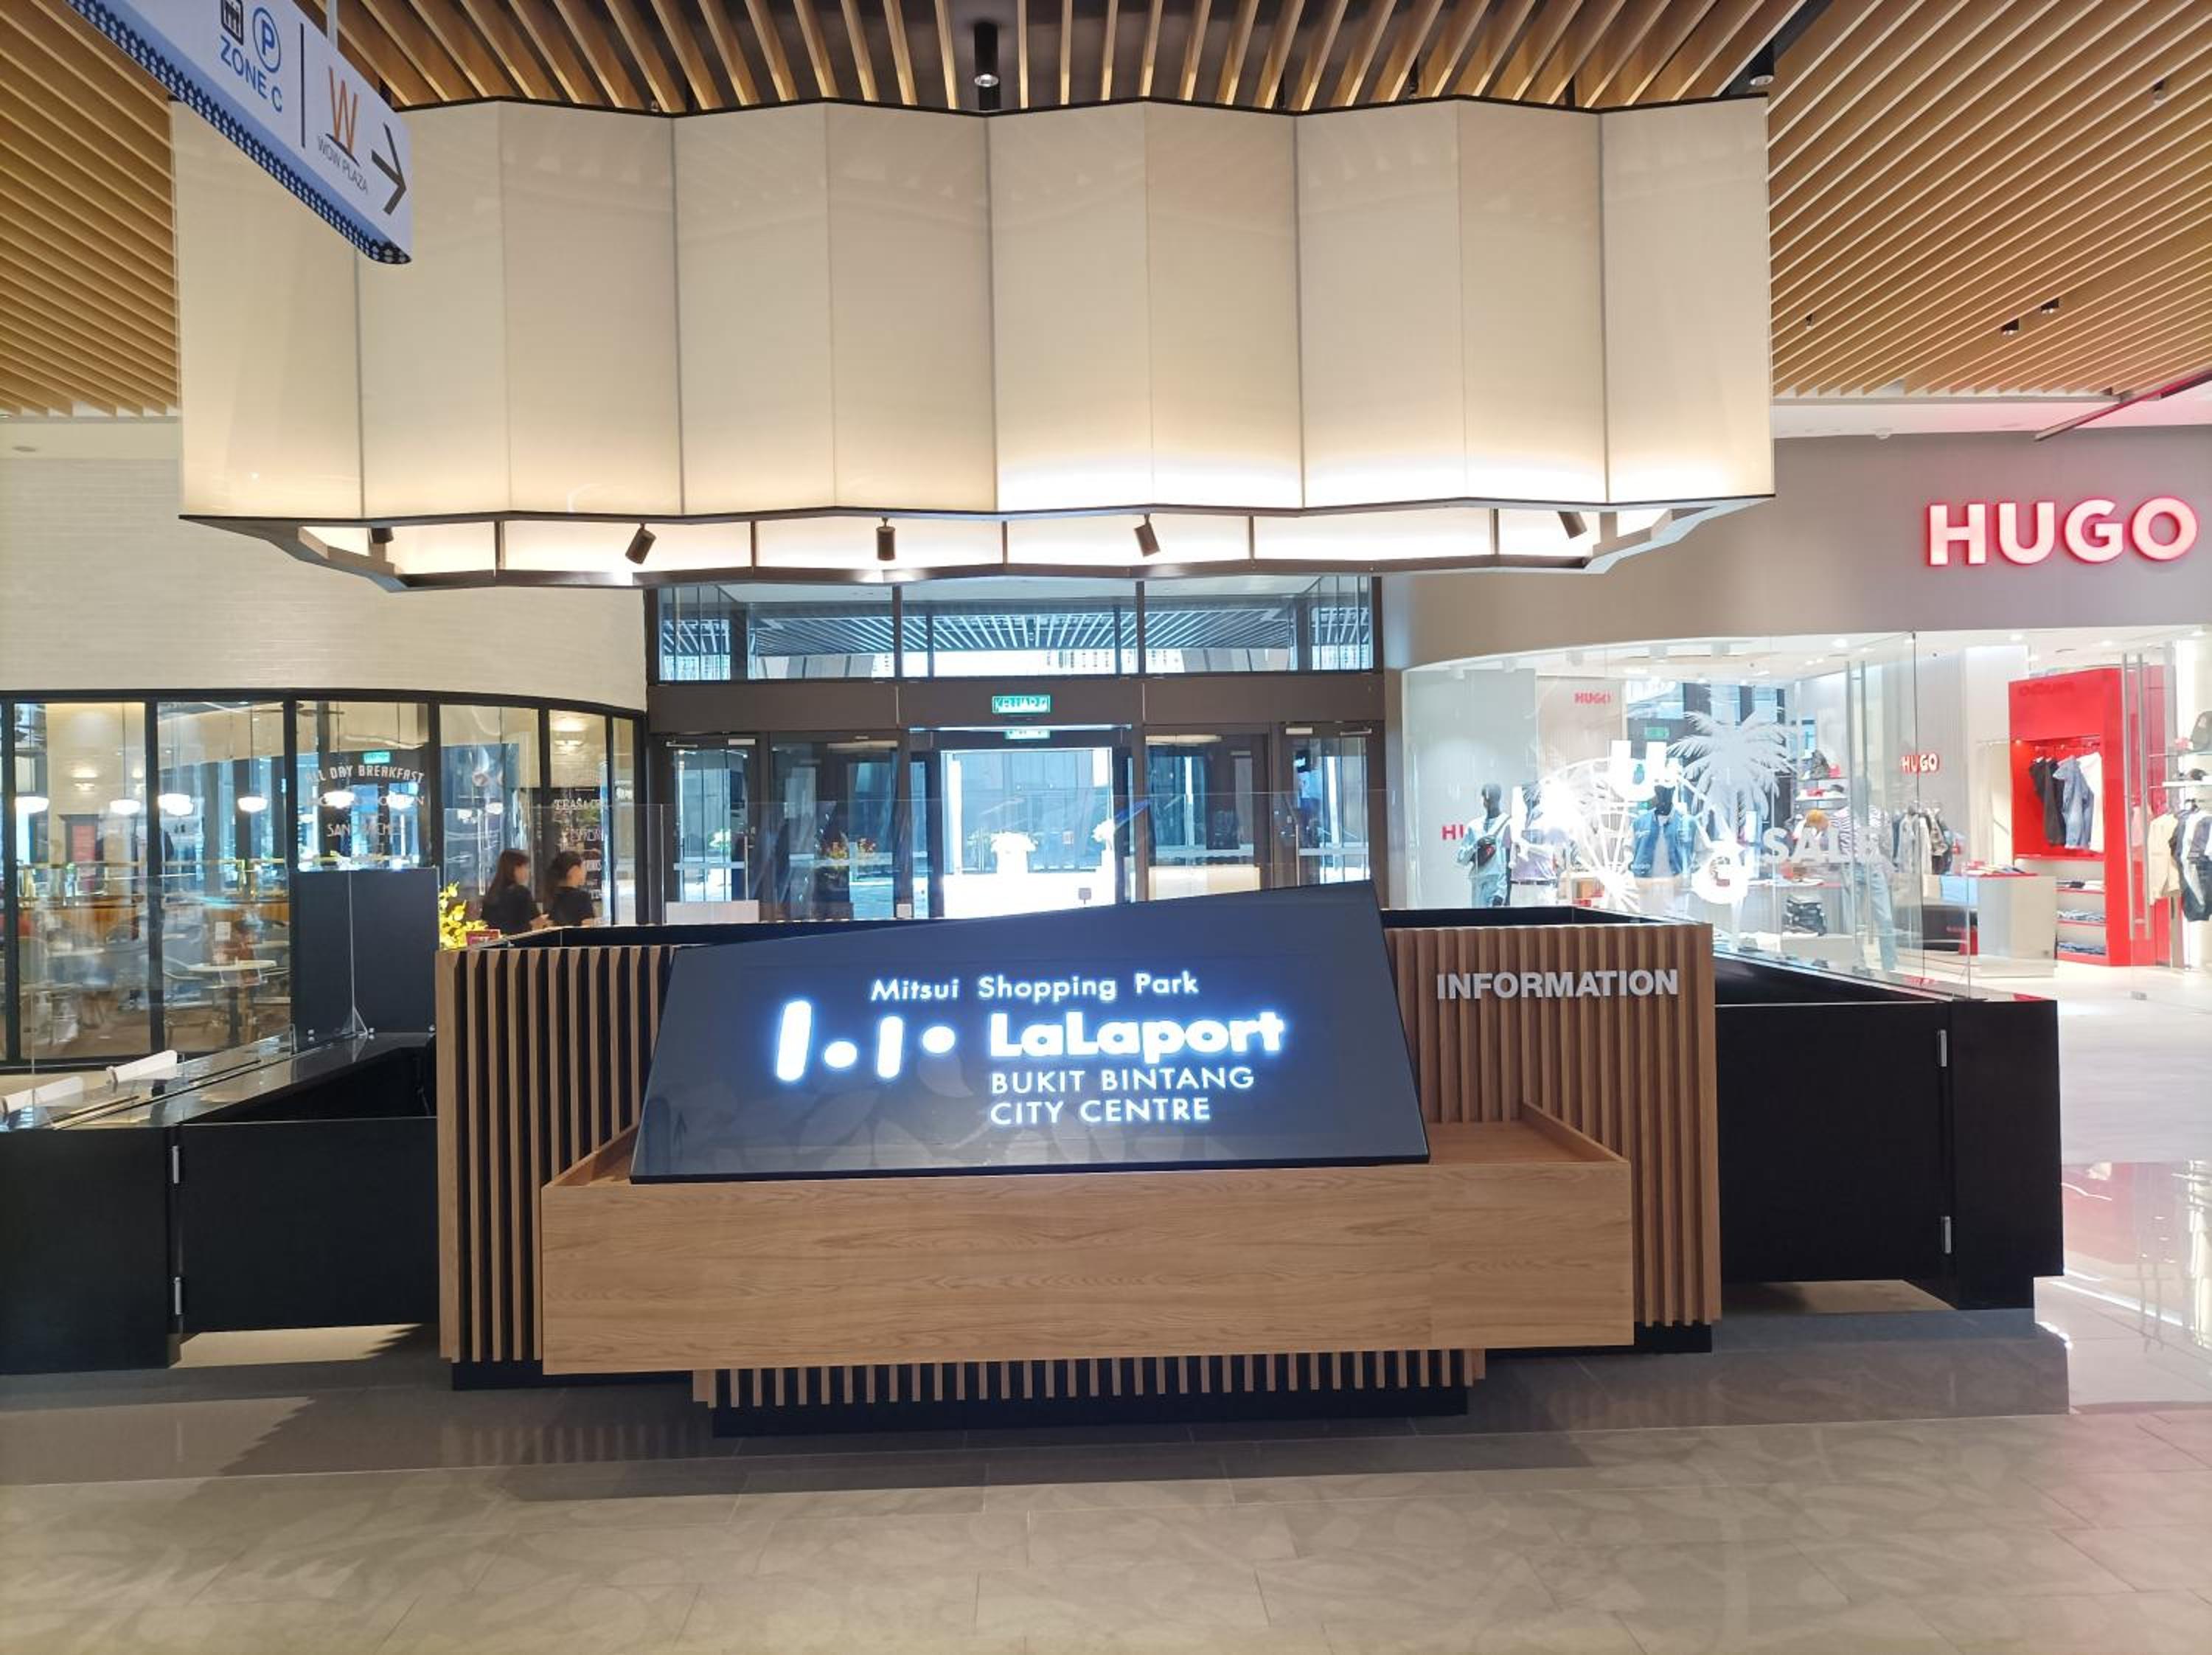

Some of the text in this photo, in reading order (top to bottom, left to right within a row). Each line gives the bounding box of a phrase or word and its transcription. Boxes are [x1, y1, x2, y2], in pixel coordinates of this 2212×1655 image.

[220, 35, 283, 113] ZONE C
[318, 134, 369, 194] WOW PLAZA
[1927, 496, 2199, 566] HUGO
[330, 764, 353, 780] DAY
[358, 764, 425, 784] BREAKFAST
[1902, 753, 1939, 773] HUGO
[871, 971, 1199, 1004] Mitsui Shopping Park
[1437, 969, 1678, 999] INFORMATION
[989, 1010, 1286, 1064] LaLaport
[991, 1066, 1255, 1094] BUKIT BINTANG
[990, 1097, 1211, 1125] CITY CENTRE
